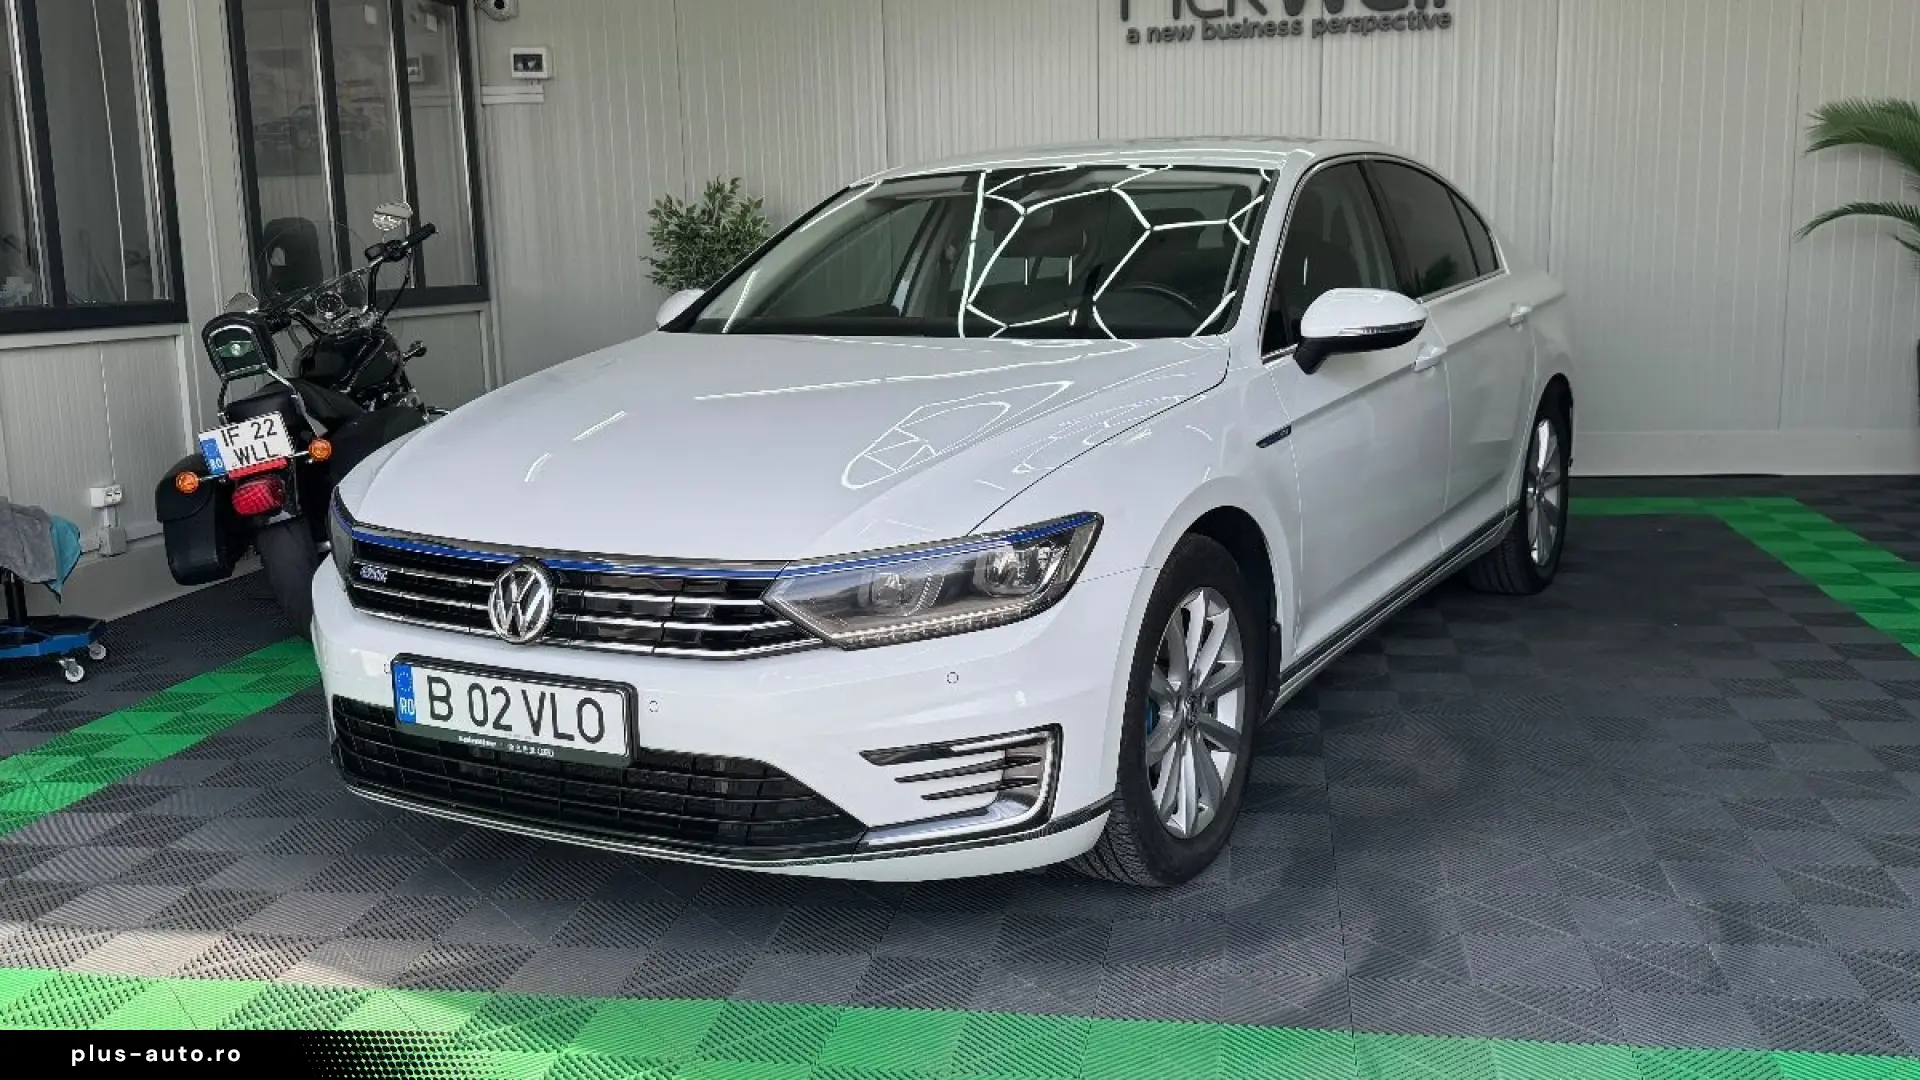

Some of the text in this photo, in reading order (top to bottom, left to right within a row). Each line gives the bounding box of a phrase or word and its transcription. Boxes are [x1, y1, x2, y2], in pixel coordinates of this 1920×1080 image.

[1126, 27, 1141, 44] a
[1146, 24, 1195, 43] new
[1202, 16, 1303, 41] business
[1312, 10, 1452, 39] perspective
[221, 418, 278, 447] IF 22
[233, 441, 279, 465] WLL
[400, 697, 415, 715] RO
[427, 675, 605, 744] B 02 VLO
